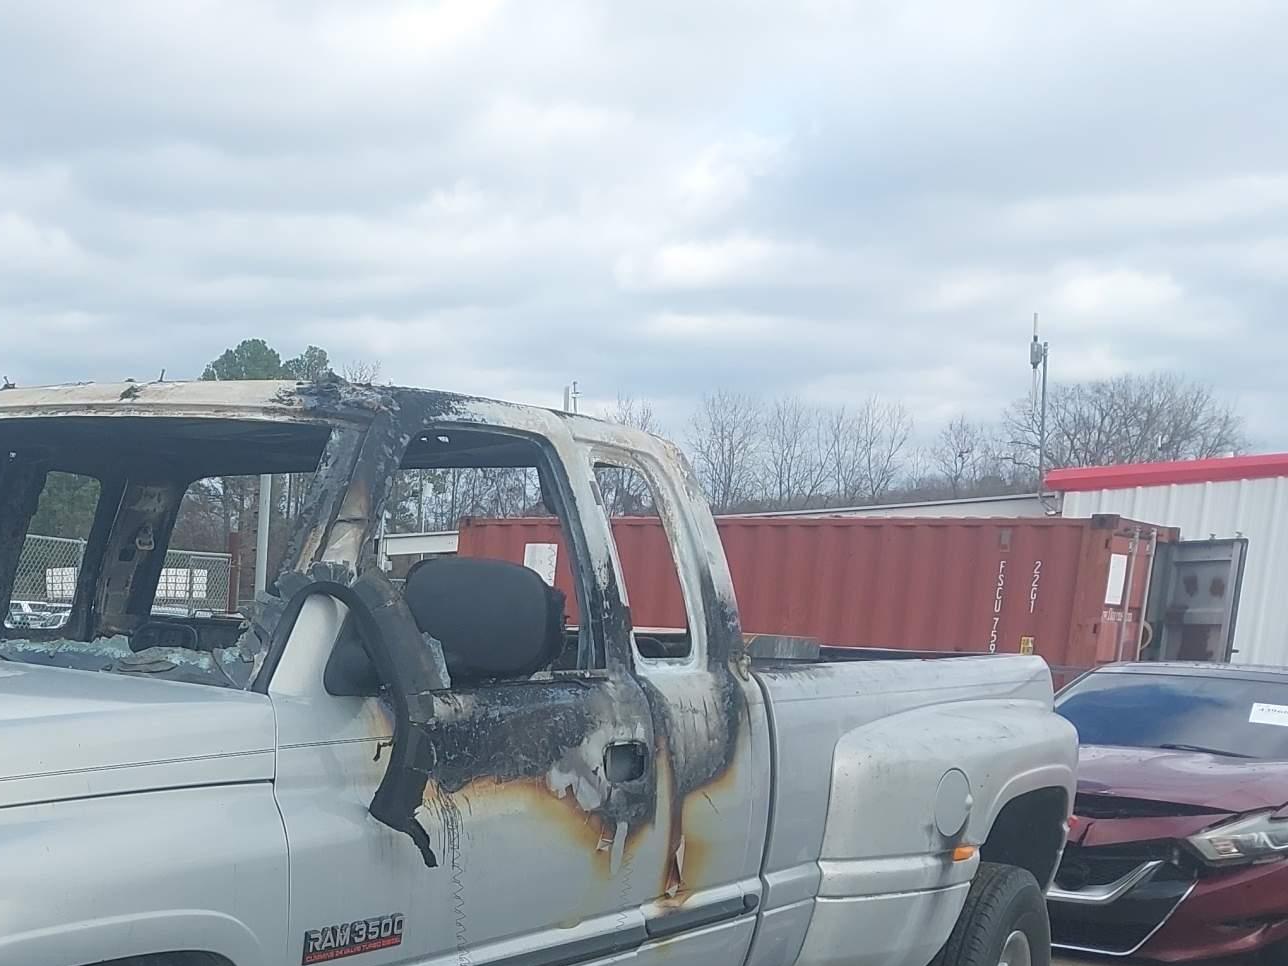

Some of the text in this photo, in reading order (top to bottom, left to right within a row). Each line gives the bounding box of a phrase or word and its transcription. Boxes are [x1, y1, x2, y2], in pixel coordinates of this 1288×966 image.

[993, 560, 1007, 613] FSCU
[1029, 560, 1042, 614] 22G1
[310, 924, 351, 952] RAM
